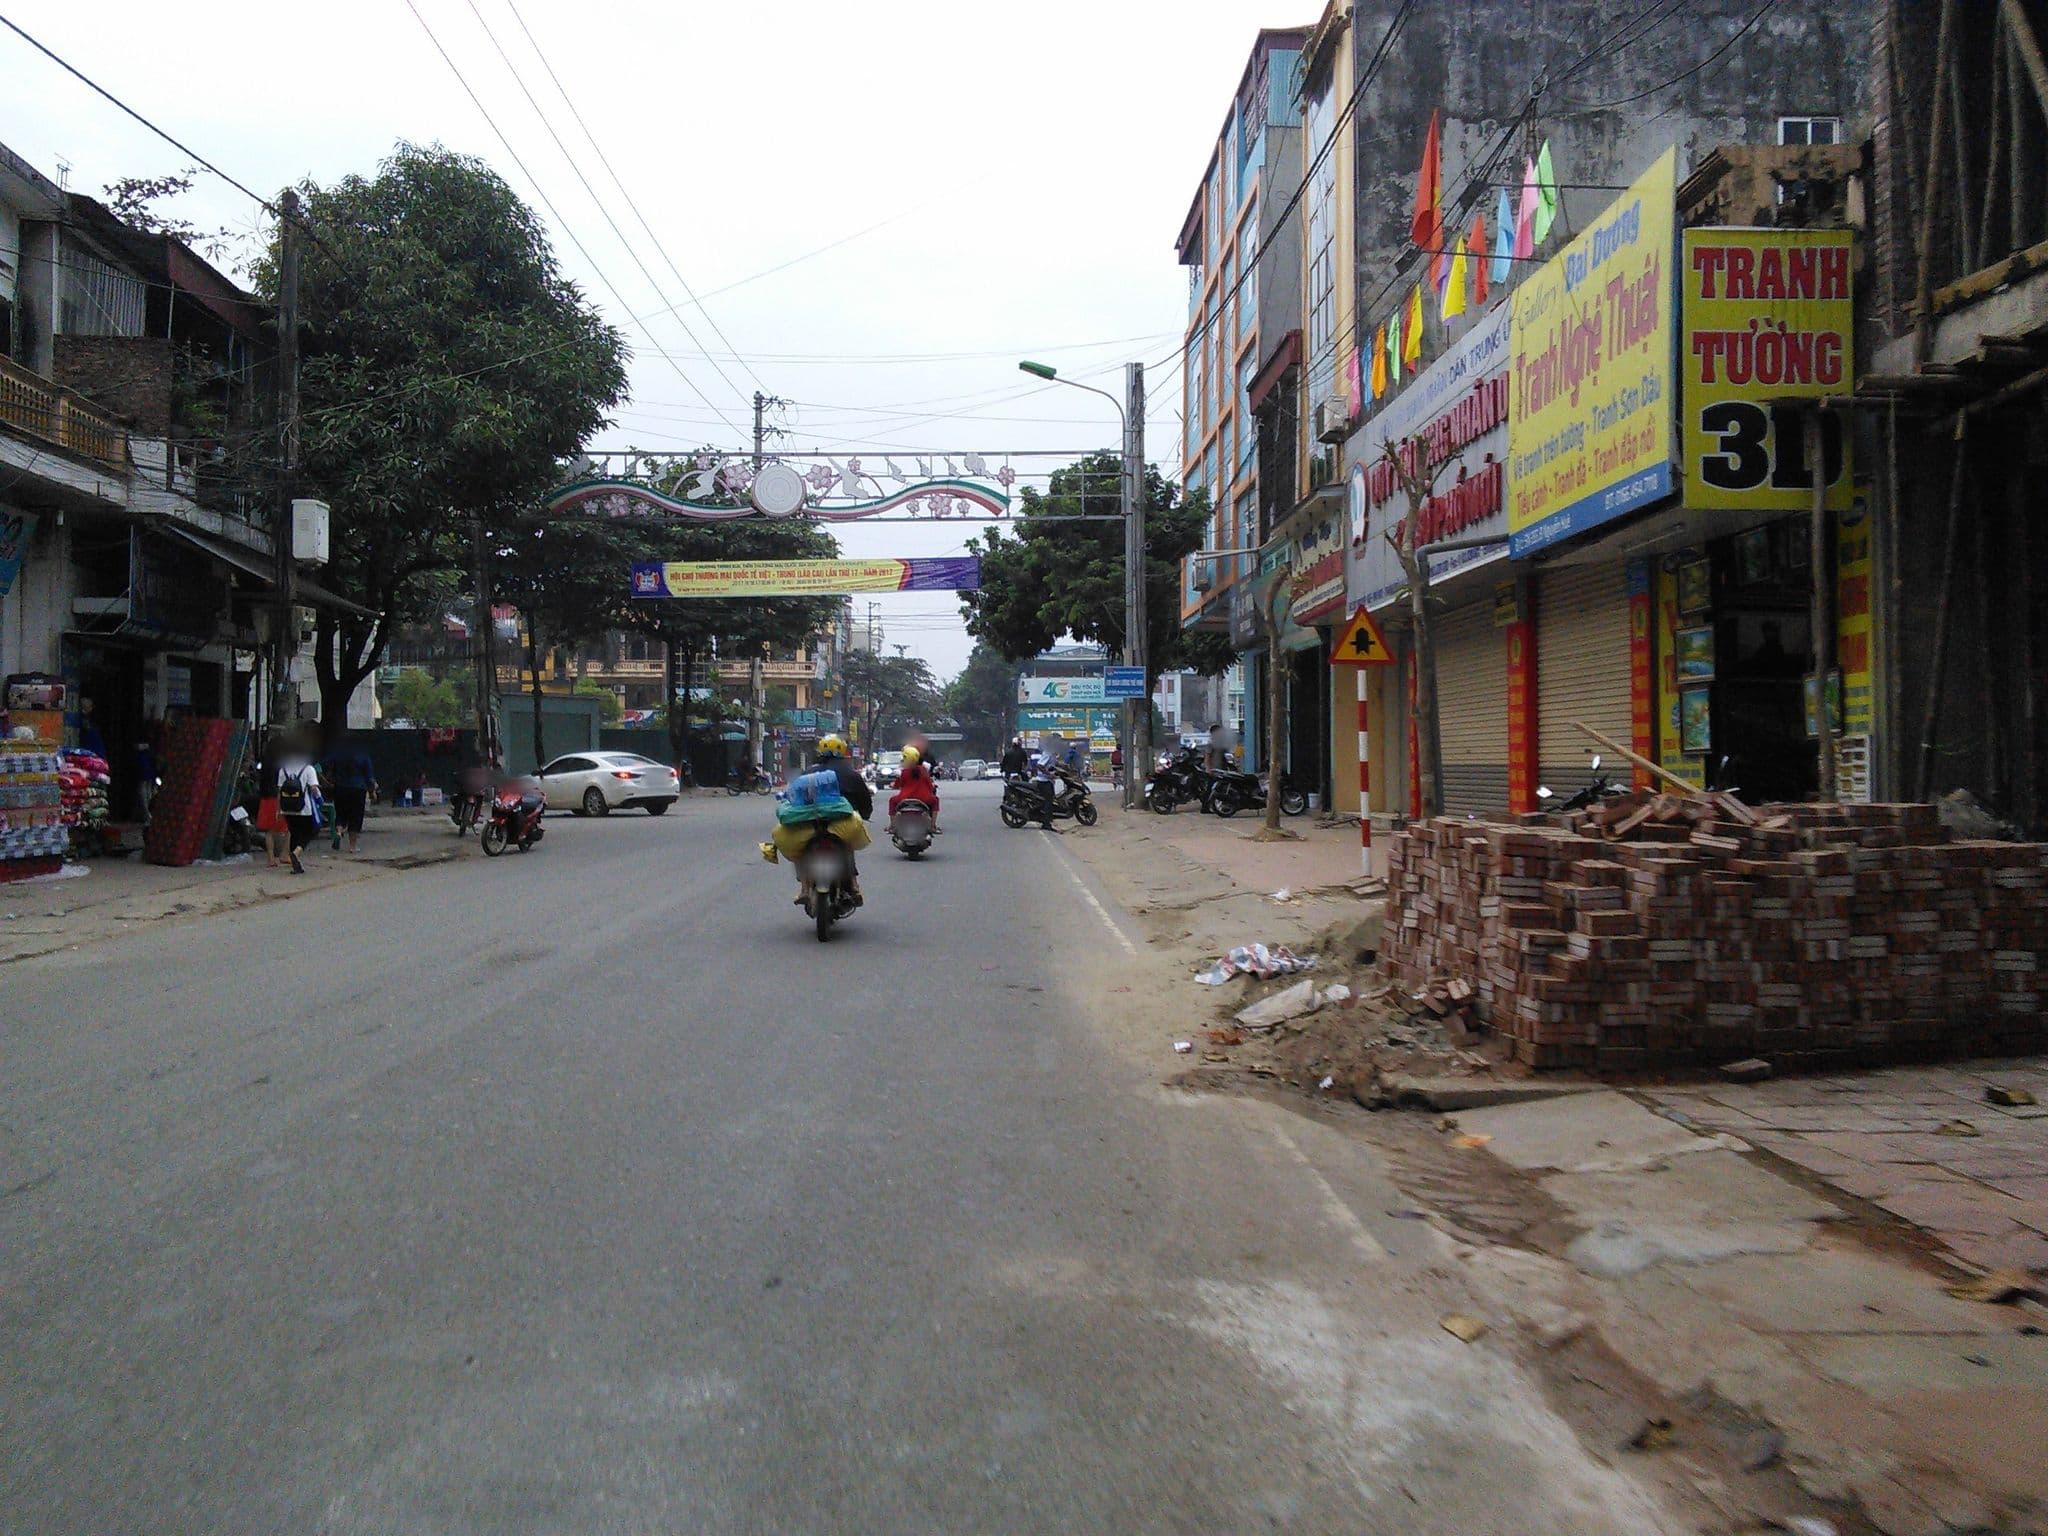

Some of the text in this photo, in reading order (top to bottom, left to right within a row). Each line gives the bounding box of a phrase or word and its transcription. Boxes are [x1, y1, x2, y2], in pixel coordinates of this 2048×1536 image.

[1693, 246, 1850, 299] TRANH
[1516, 248, 1661, 423] Tranh Nghệ Thuật
[1692, 316, 1843, 386] TƯỜNG
[1701, 401, 1843, 490] 3D
[733, 569, 749, 580] QUỐC
[851, 569, 858, 577] 17
[1042, 681, 1069, 699] 4G
